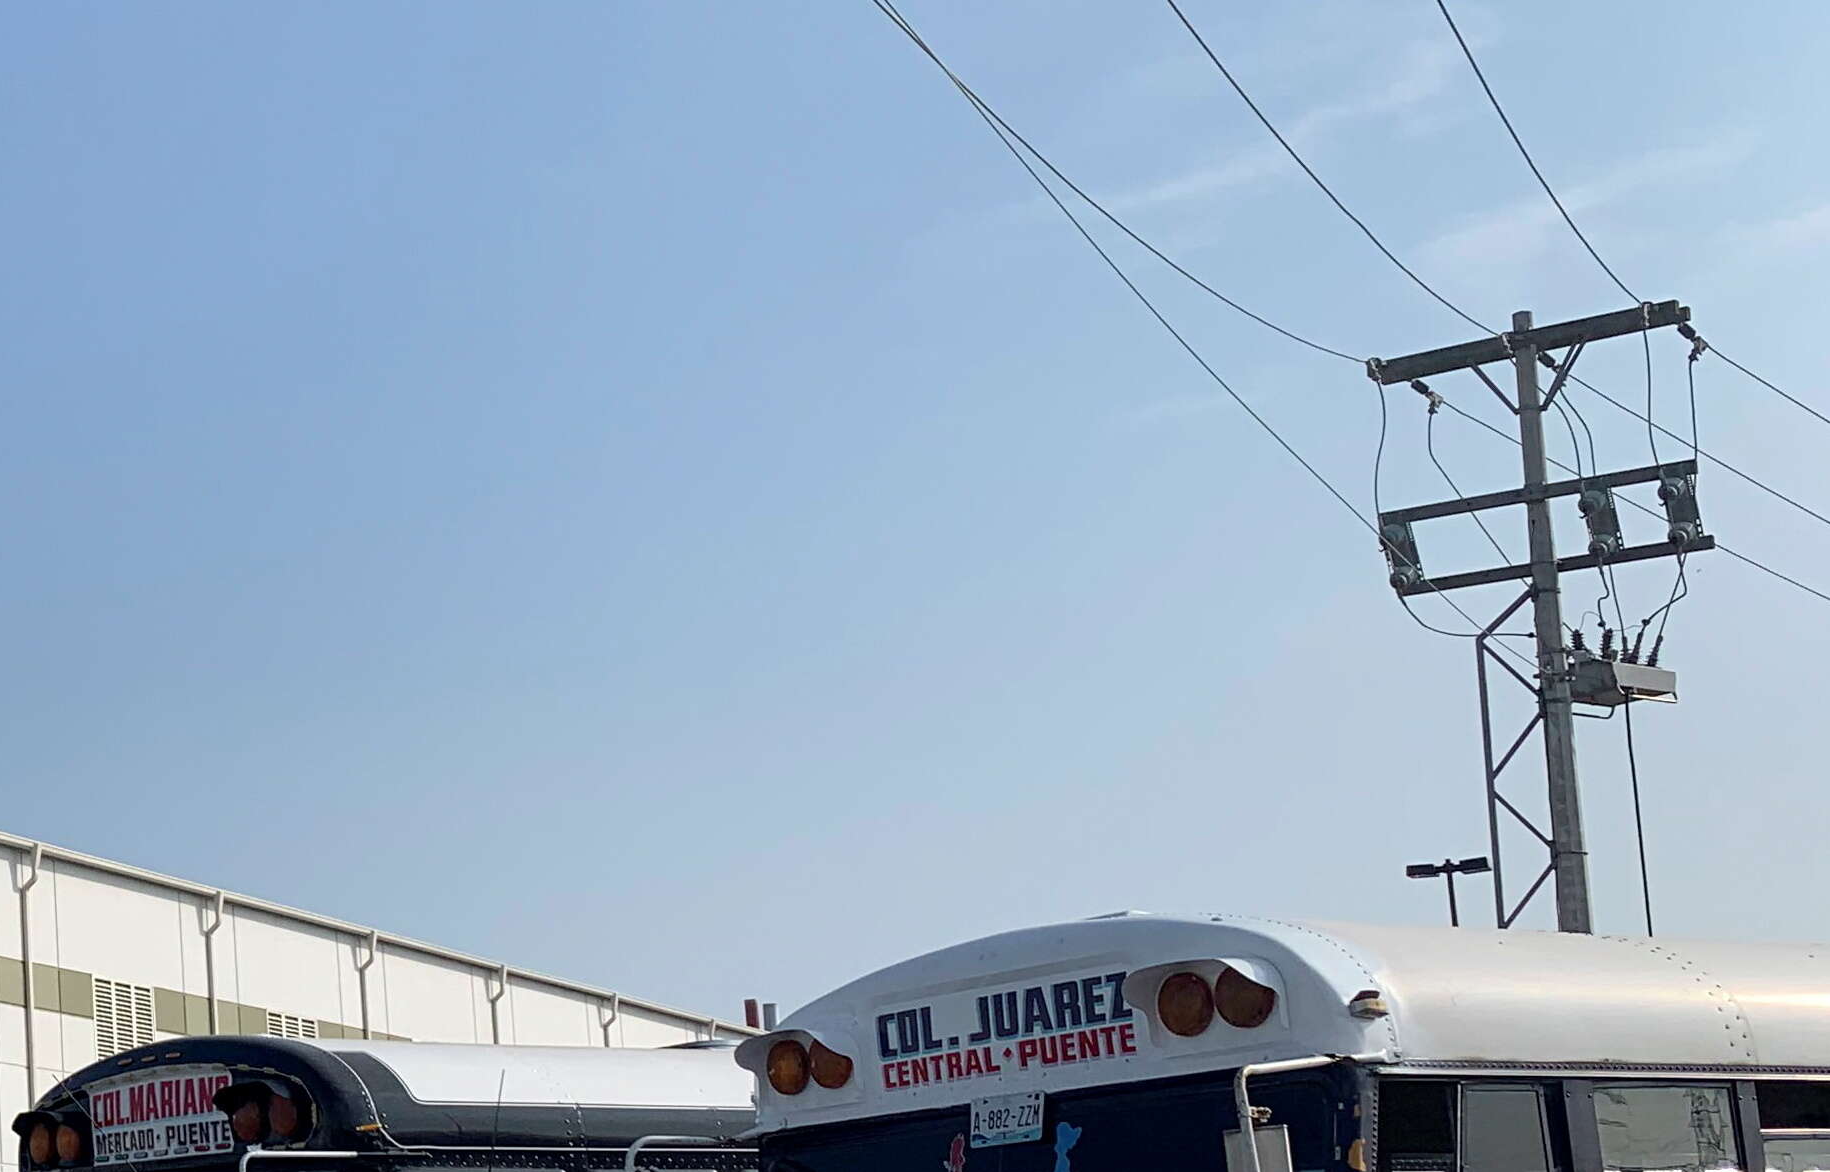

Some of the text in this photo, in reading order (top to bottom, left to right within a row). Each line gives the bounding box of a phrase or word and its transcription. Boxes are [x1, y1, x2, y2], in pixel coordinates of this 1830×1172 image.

[876, 971, 1134, 1060] COL. JUAREZ
[882, 1023, 1137, 1091] CENTRAL PUENTE
[129, 1075, 230, 1124] MARIAN
[96, 1120, 231, 1155] MERCADO PUENTE
